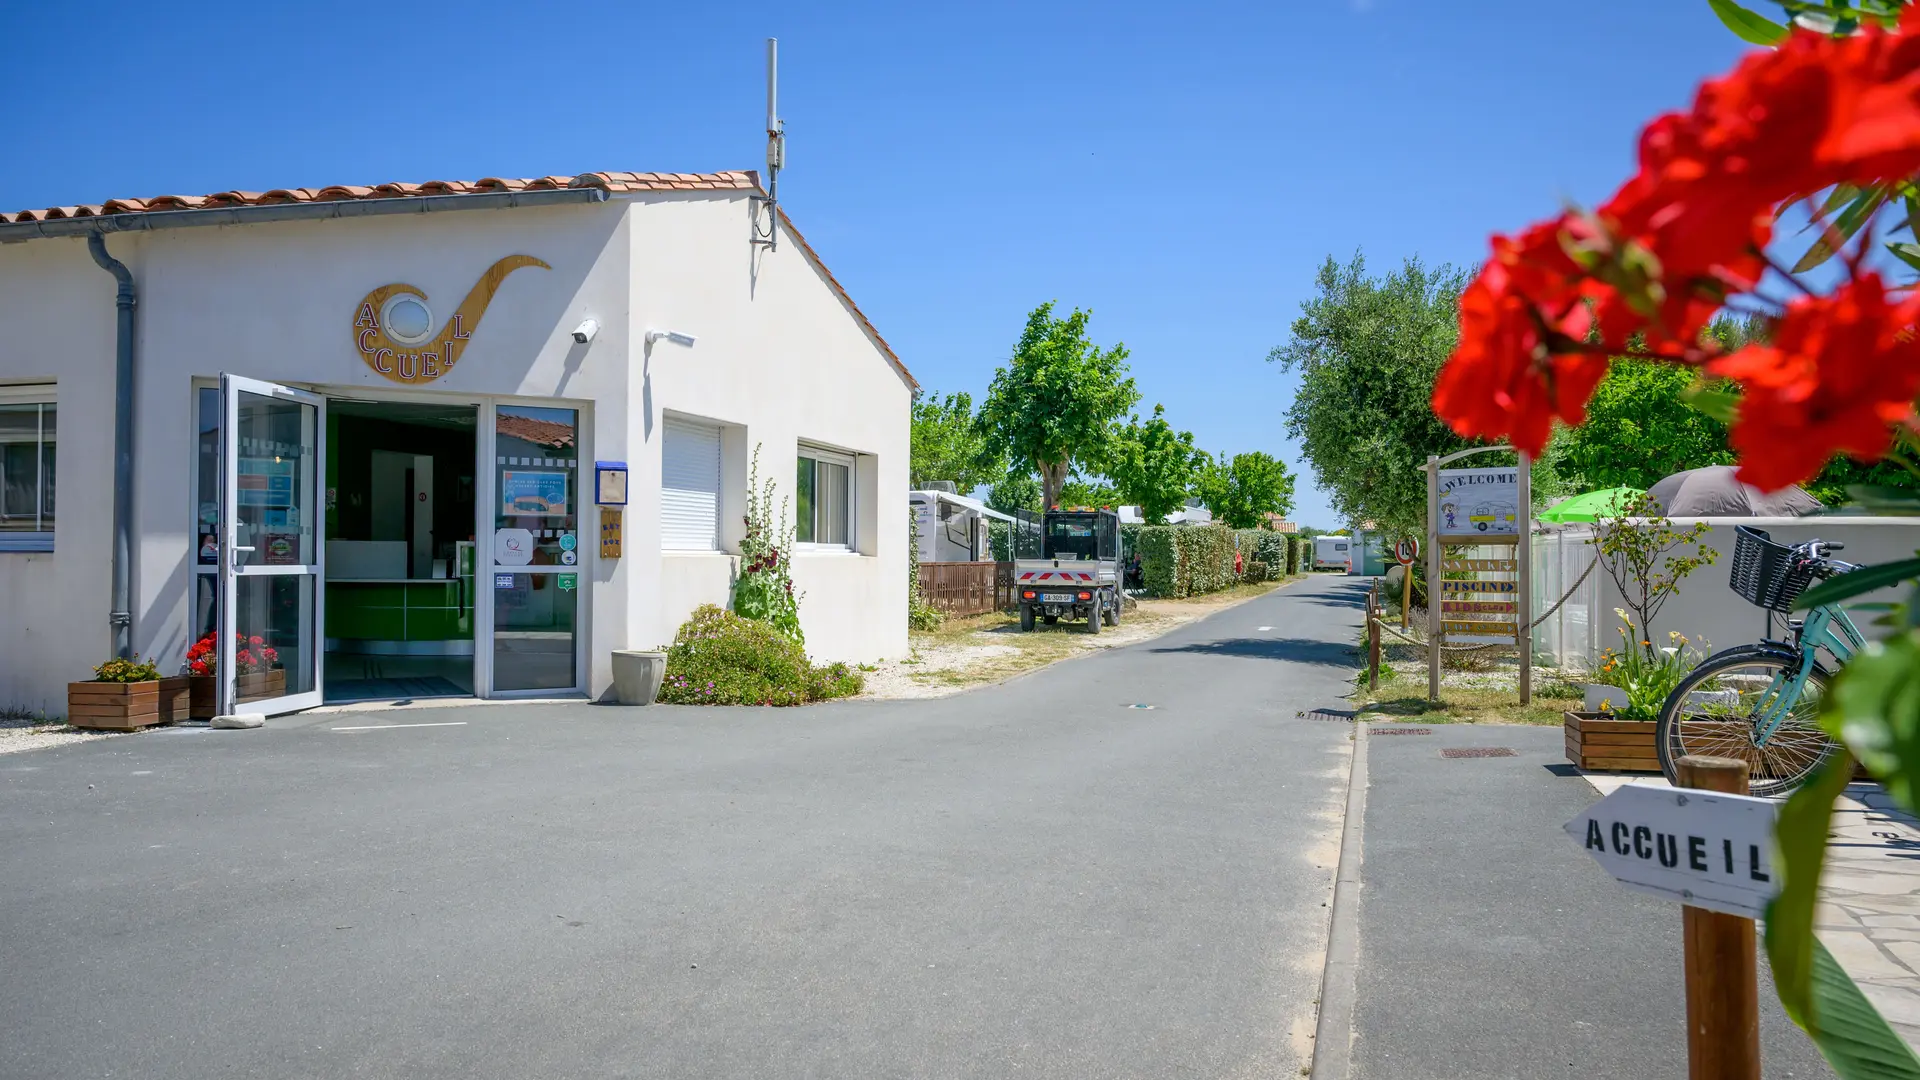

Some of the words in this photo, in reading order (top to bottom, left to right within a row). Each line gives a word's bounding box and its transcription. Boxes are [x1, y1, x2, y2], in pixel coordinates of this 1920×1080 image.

[356, 302, 471, 379] ACCUEIL
[1444, 473, 1517, 491] WELCOME
[1443, 561, 1496, 570] SNACK
[1586, 818, 1770, 883] ACCUEIL
